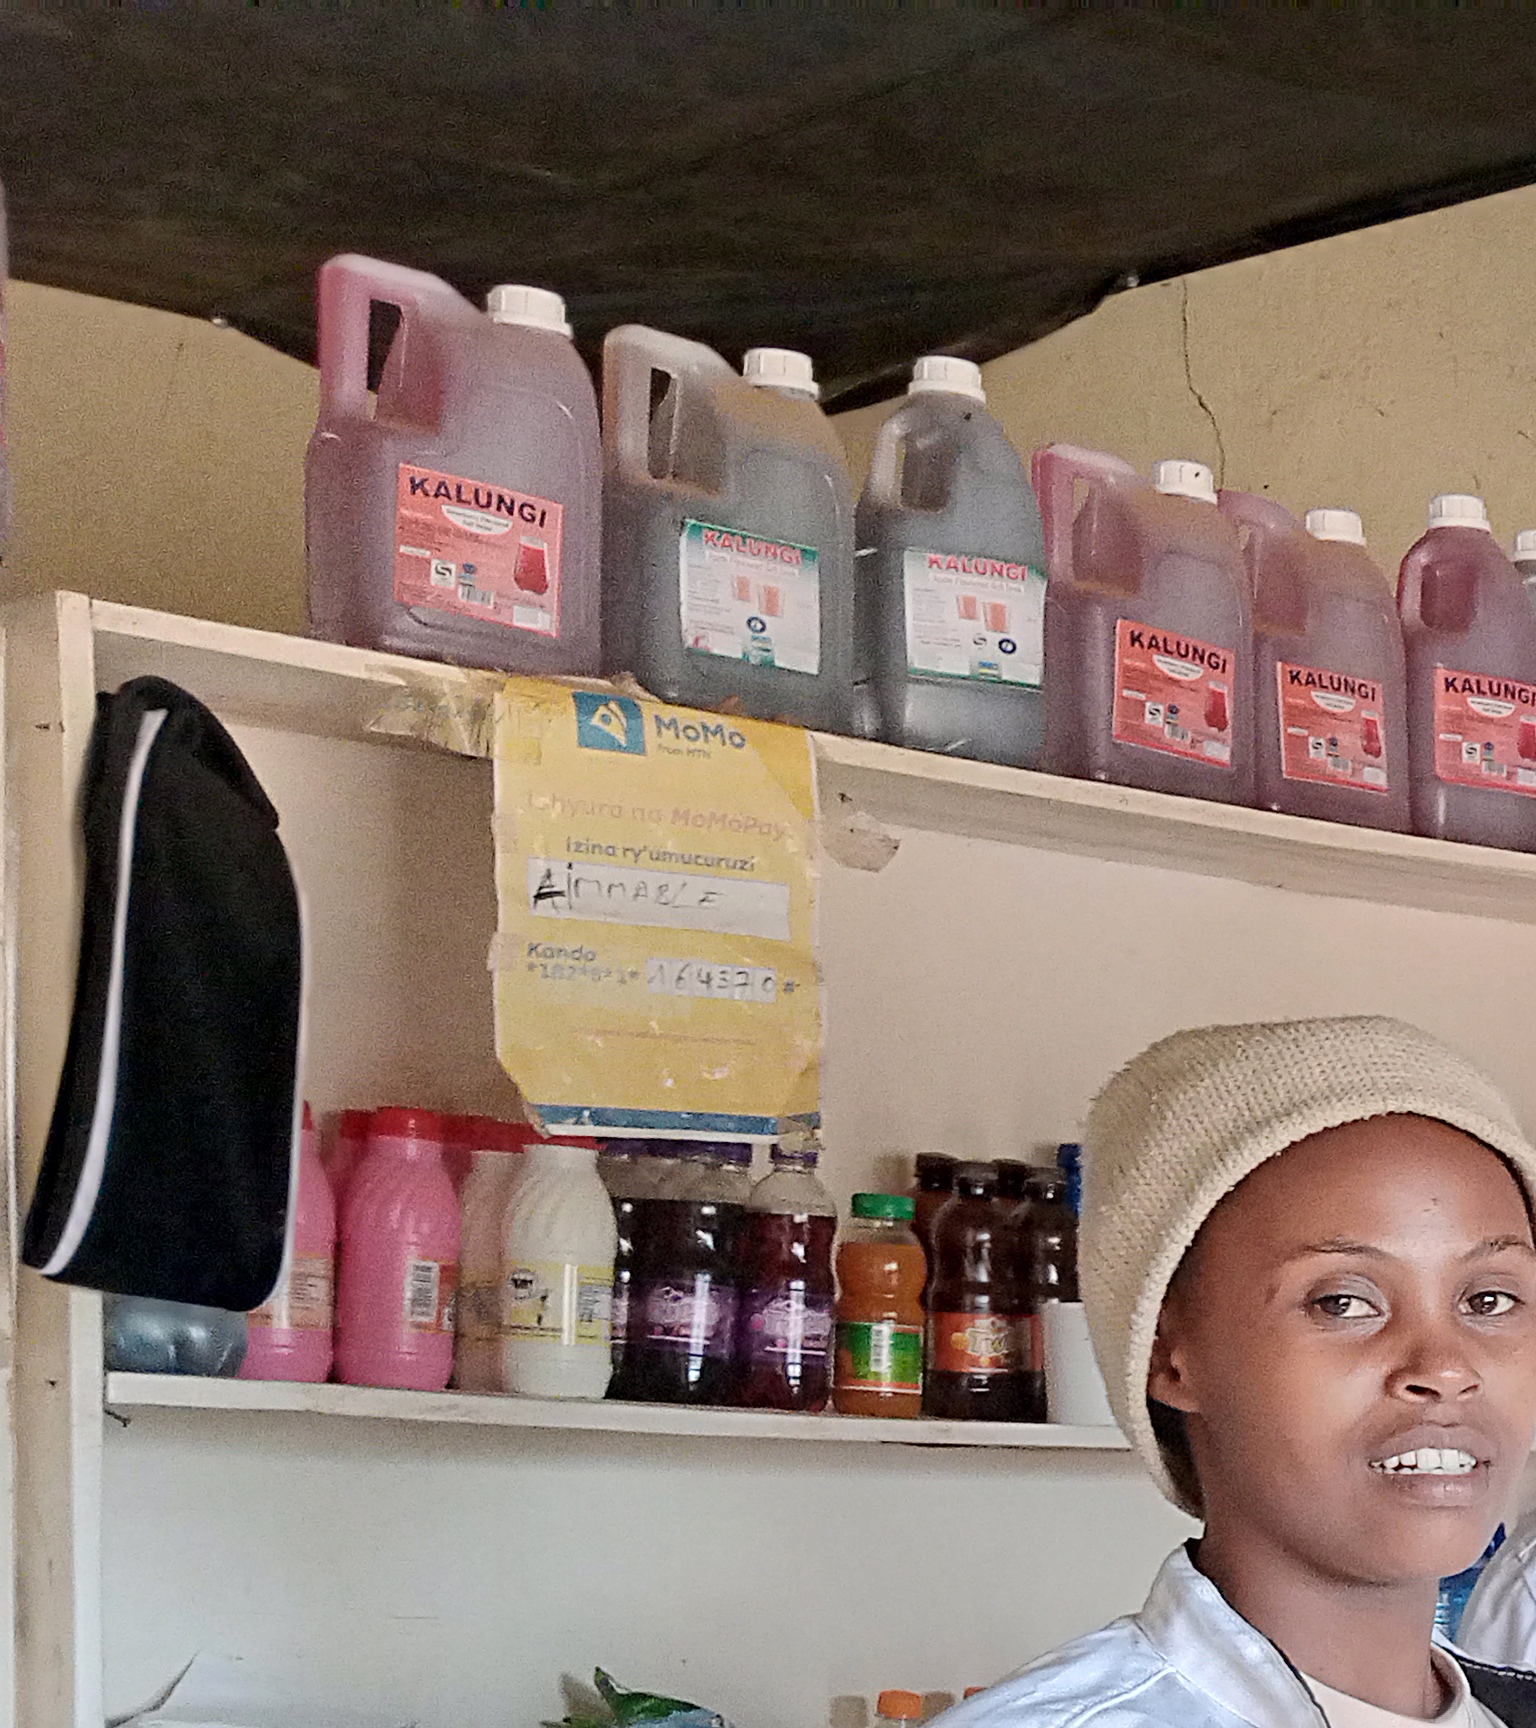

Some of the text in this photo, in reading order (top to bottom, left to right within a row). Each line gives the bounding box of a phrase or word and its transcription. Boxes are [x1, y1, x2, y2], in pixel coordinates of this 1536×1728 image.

[409, 475, 547, 528] KALUNGI
[702, 528, 802, 566] KALUNGI
[927, 553, 1029, 582] KALUNGI
[1129, 629, 1228, 675] KALUNGI
[1288, 669, 1377, 703] KALUNGI
[1444, 676, 1536, 708] KALUNGI
[654, 713, 747, 750] MoMo
[566, 836, 756, 873] Izina ry'umucuruzi
